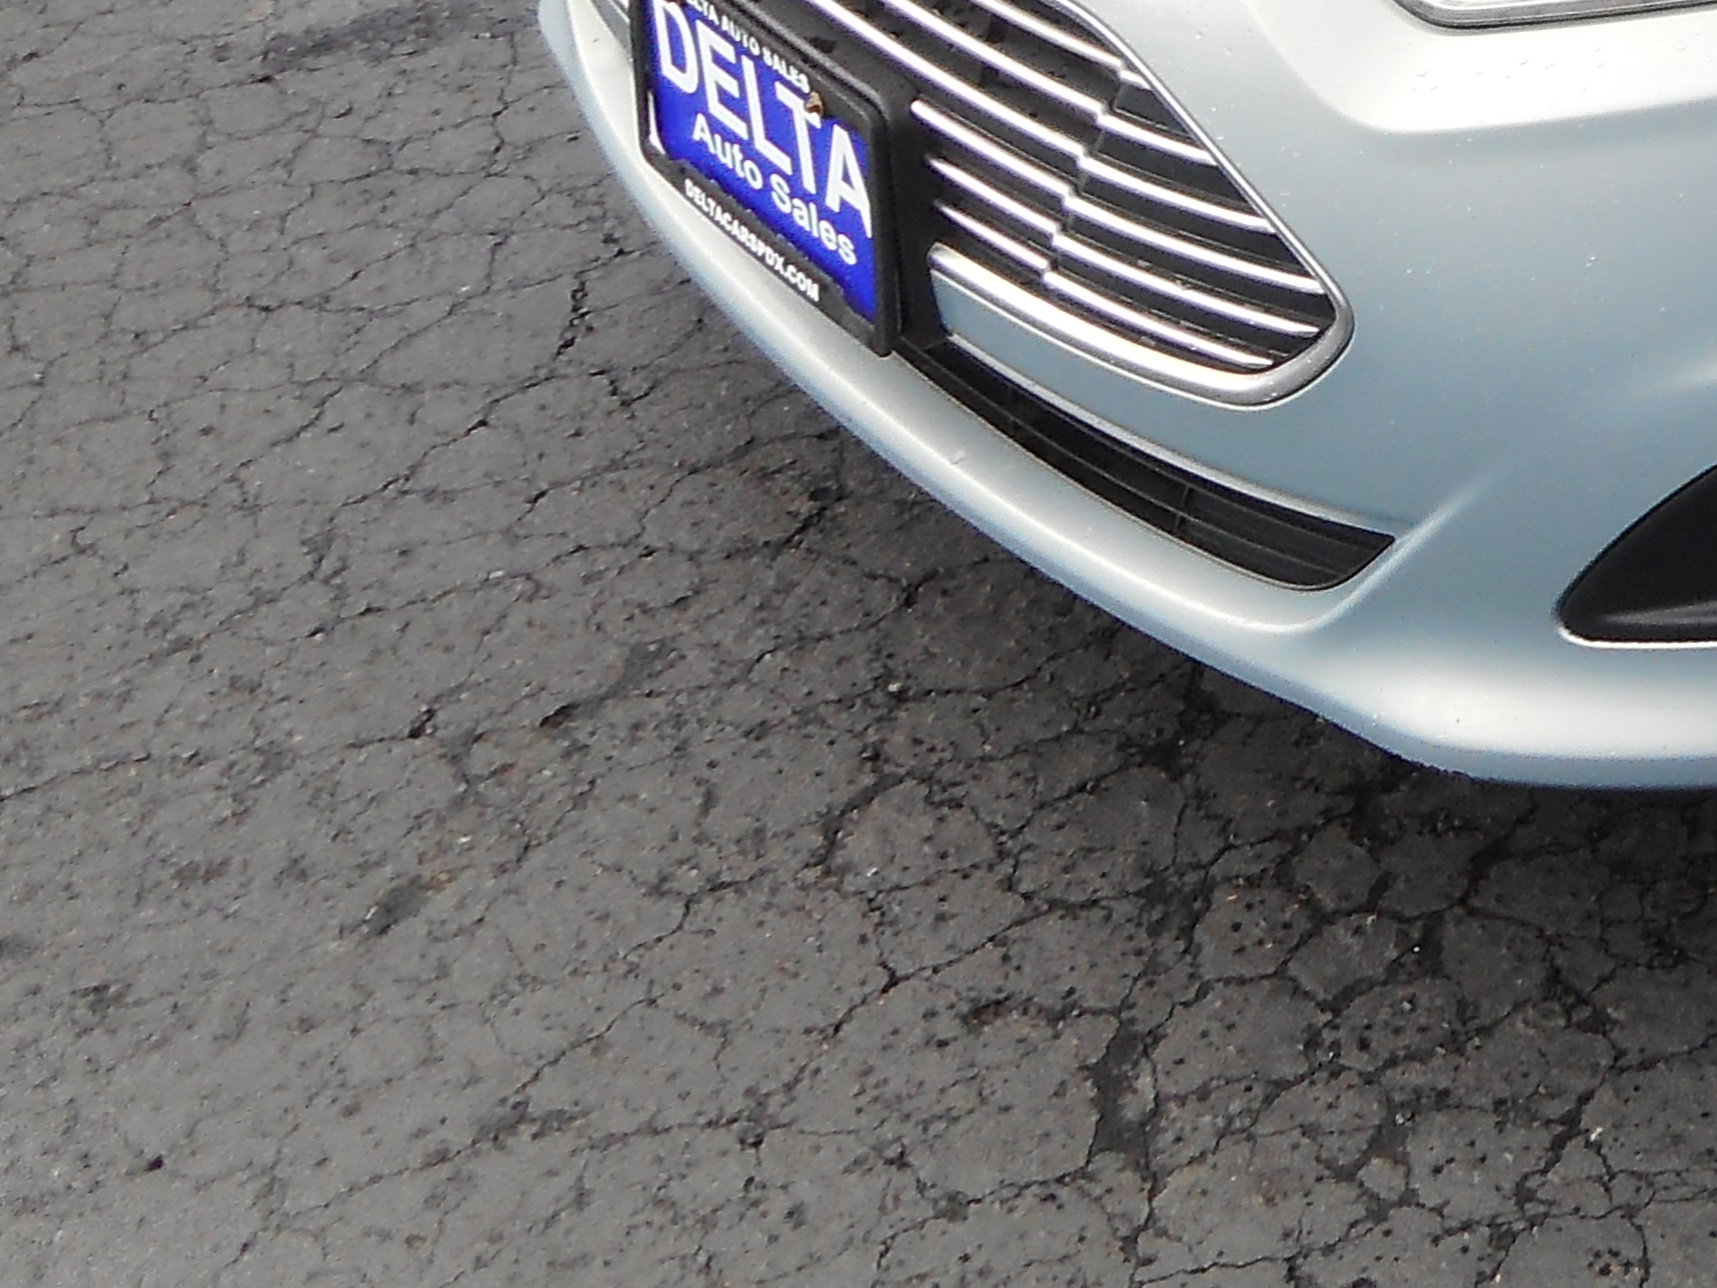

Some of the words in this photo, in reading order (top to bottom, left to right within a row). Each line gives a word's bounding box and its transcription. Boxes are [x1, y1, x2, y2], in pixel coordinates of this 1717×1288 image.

[761, 44, 810, 95] SALES
[692, 112, 764, 189] Auto
[769, 174, 859, 266] Sales
